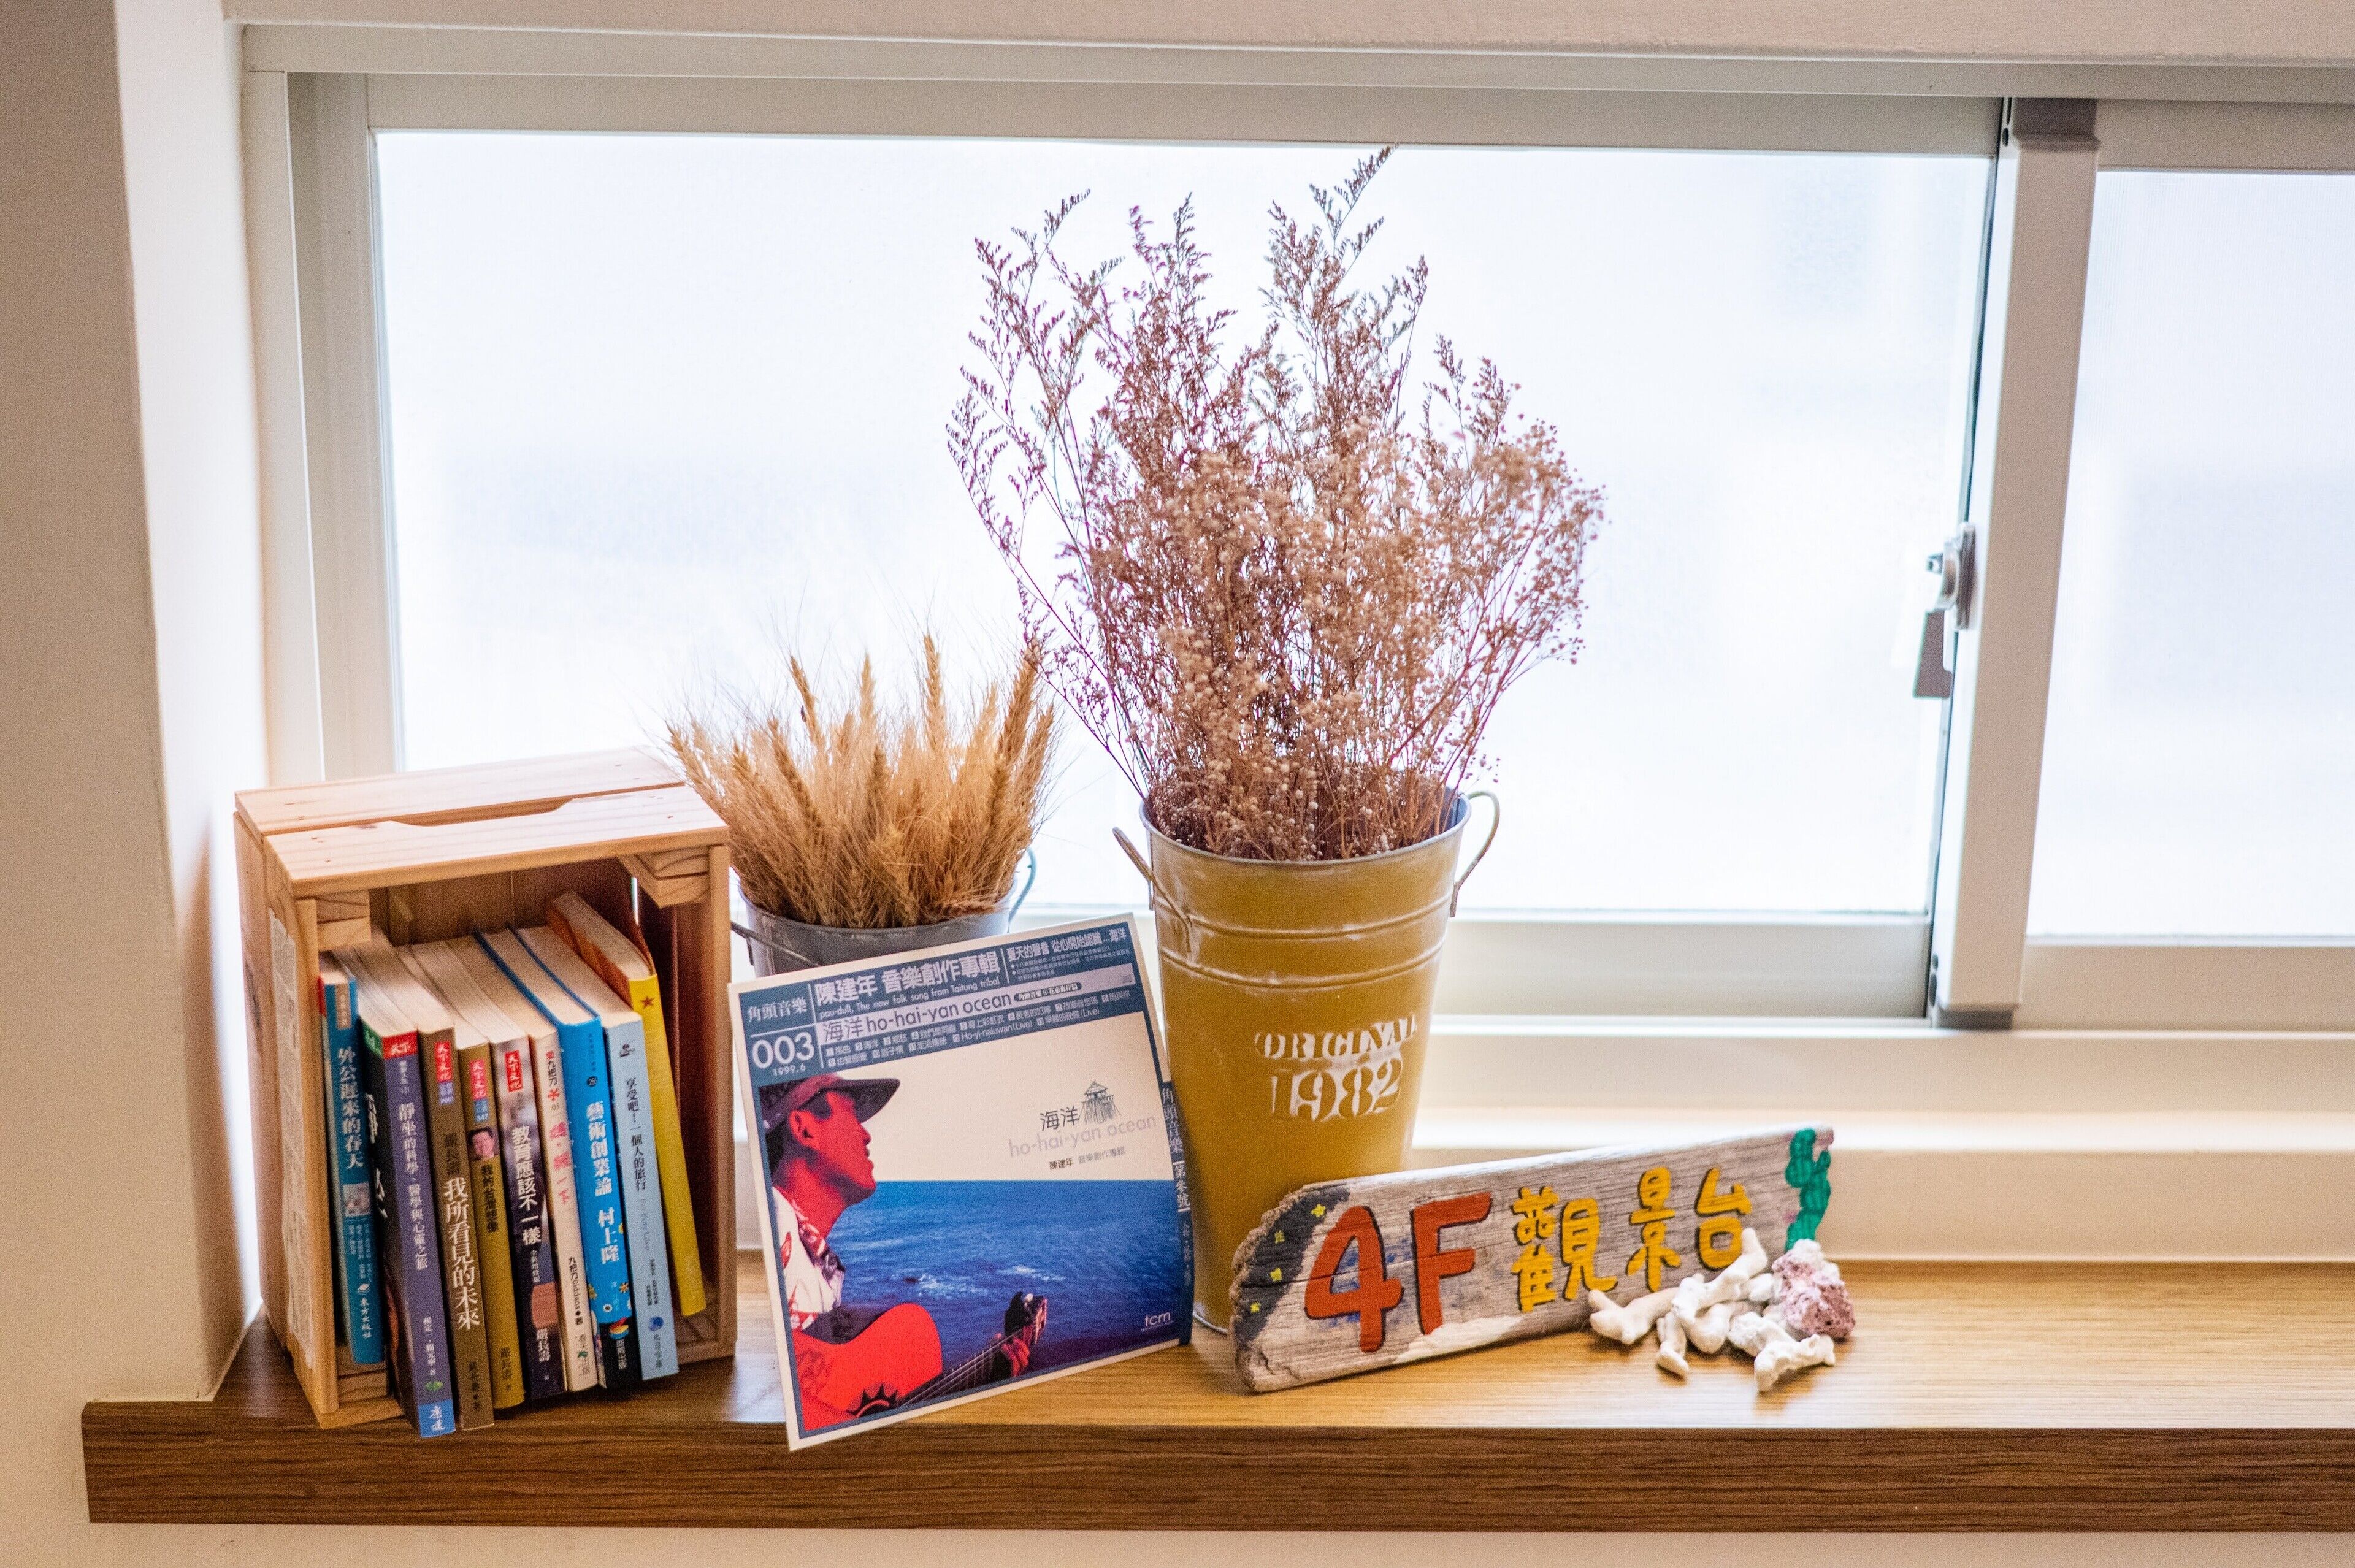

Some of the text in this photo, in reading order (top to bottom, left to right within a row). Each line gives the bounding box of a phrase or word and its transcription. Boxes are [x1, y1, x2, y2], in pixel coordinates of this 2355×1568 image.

[814, 973, 878, 1007] 陳建年
[881, 950, 1001, 994] 音樂創作專輯
[855, 1000, 870, 1011] The
[872, 998, 889, 1008] new
[892, 993, 908, 1004] folk
[909, 991, 929, 1003] song
[930, 985, 949, 997] from
[950, 979, 978, 995] Taitung
[979, 976, 1000, 987] tribal
[748, 997, 807, 1022] 角頭音樂
[822, 993, 1013, 1044] 海洋 ho-hai-yan ocean
[752, 1031, 815, 1069] 003
[1254, 1013, 1416, 1062] ORIGINAL
[437, 1043, 451, 1080] 天下文化
[472, 1062, 487, 1099] 天下文化
[508, 1052, 522, 1091] 天下文化
[773, 1064, 806, 1076] 1999.6
[338, 1046, 364, 1169] 外公遲來的春天
[1271, 1058, 1403, 1122] 1982
[1008, 1116, 1157, 1158] ho-hai-yan ocean
[1040, 1106, 1080, 1131] 海洋
[1161, 1087, 1184, 1154] 角頭音樂
[586, 1100, 613, 1196] 藝術創業論
[1049, 1146, 1125, 1170] 陳建年 音樂創作專輯
[512, 1125, 542, 1246] 教育應該不一樣
[443, 1177, 480, 1331] 我所看見的未來
[597, 1207, 619, 1265] 村上隆
[1303, 1191, 1493, 1352] 4F
[1510, 1165, 1753, 1313] 觀景台
[1144, 1312, 1170, 1327] tcm
[537, 1328, 551, 1363] 嚴長壽
